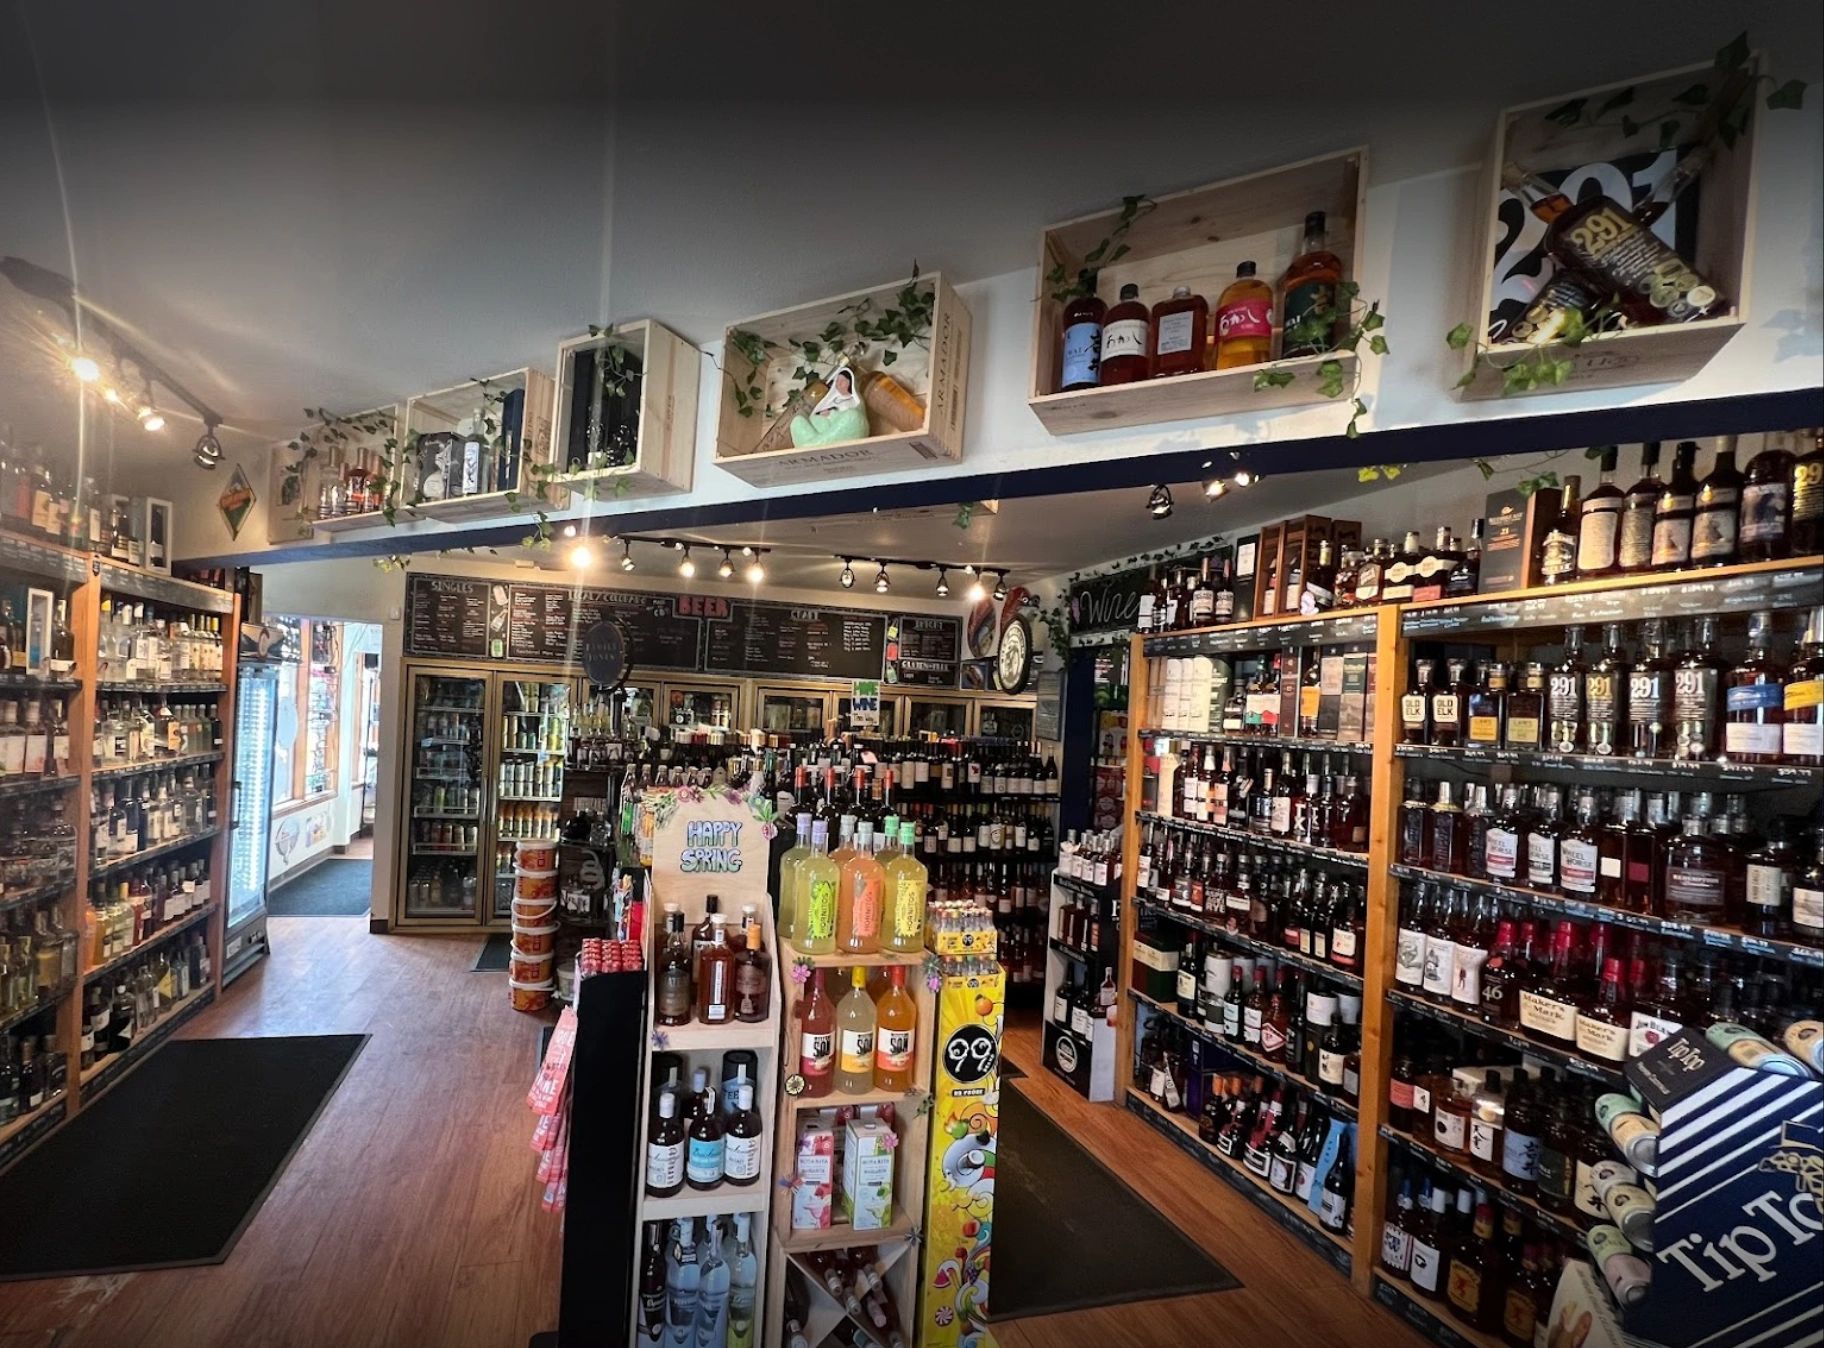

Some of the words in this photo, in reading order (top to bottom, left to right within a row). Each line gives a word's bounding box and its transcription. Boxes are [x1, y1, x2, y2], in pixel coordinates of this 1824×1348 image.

[1569, 207, 1633, 257] 291
[937, 312, 951, 416] ARMADOR
[778, 449, 875, 467] ARMADOR
[431, 581, 473, 594] SINGLES
[679, 596, 728, 618] BEER
[1080, 585, 1141, 624] Wine
[1550, 676, 1577, 697] 291
[1587, 676, 1612, 697] 291
[1631, 676, 1659, 699] 291
[1676, 670, 1705, 696] 291
[1405, 699, 1420, 707] OLD
[1405, 708, 1420, 716] ELK
[1437, 699, 1454, 707] OLD
[1437, 708, 1454, 716] ELK
[687, 820, 743, 847] HAPPY
[681, 848, 743, 873] SPRING
[820, 892, 829, 934] HORNITOS
[864, 892, 873, 932] HORNITOS
[907, 891, 916, 931] HORNITOS
[1482, 985, 1503, 1001] 46
[1523, 994, 1565, 1013] Maker's
[1534, 1005, 1565, 1020] Mark
[1579, 1019, 1617, 1036] Maker's
[1588, 1028, 1615, 1042] Mark
[948, 1037, 992, 1073] 99
